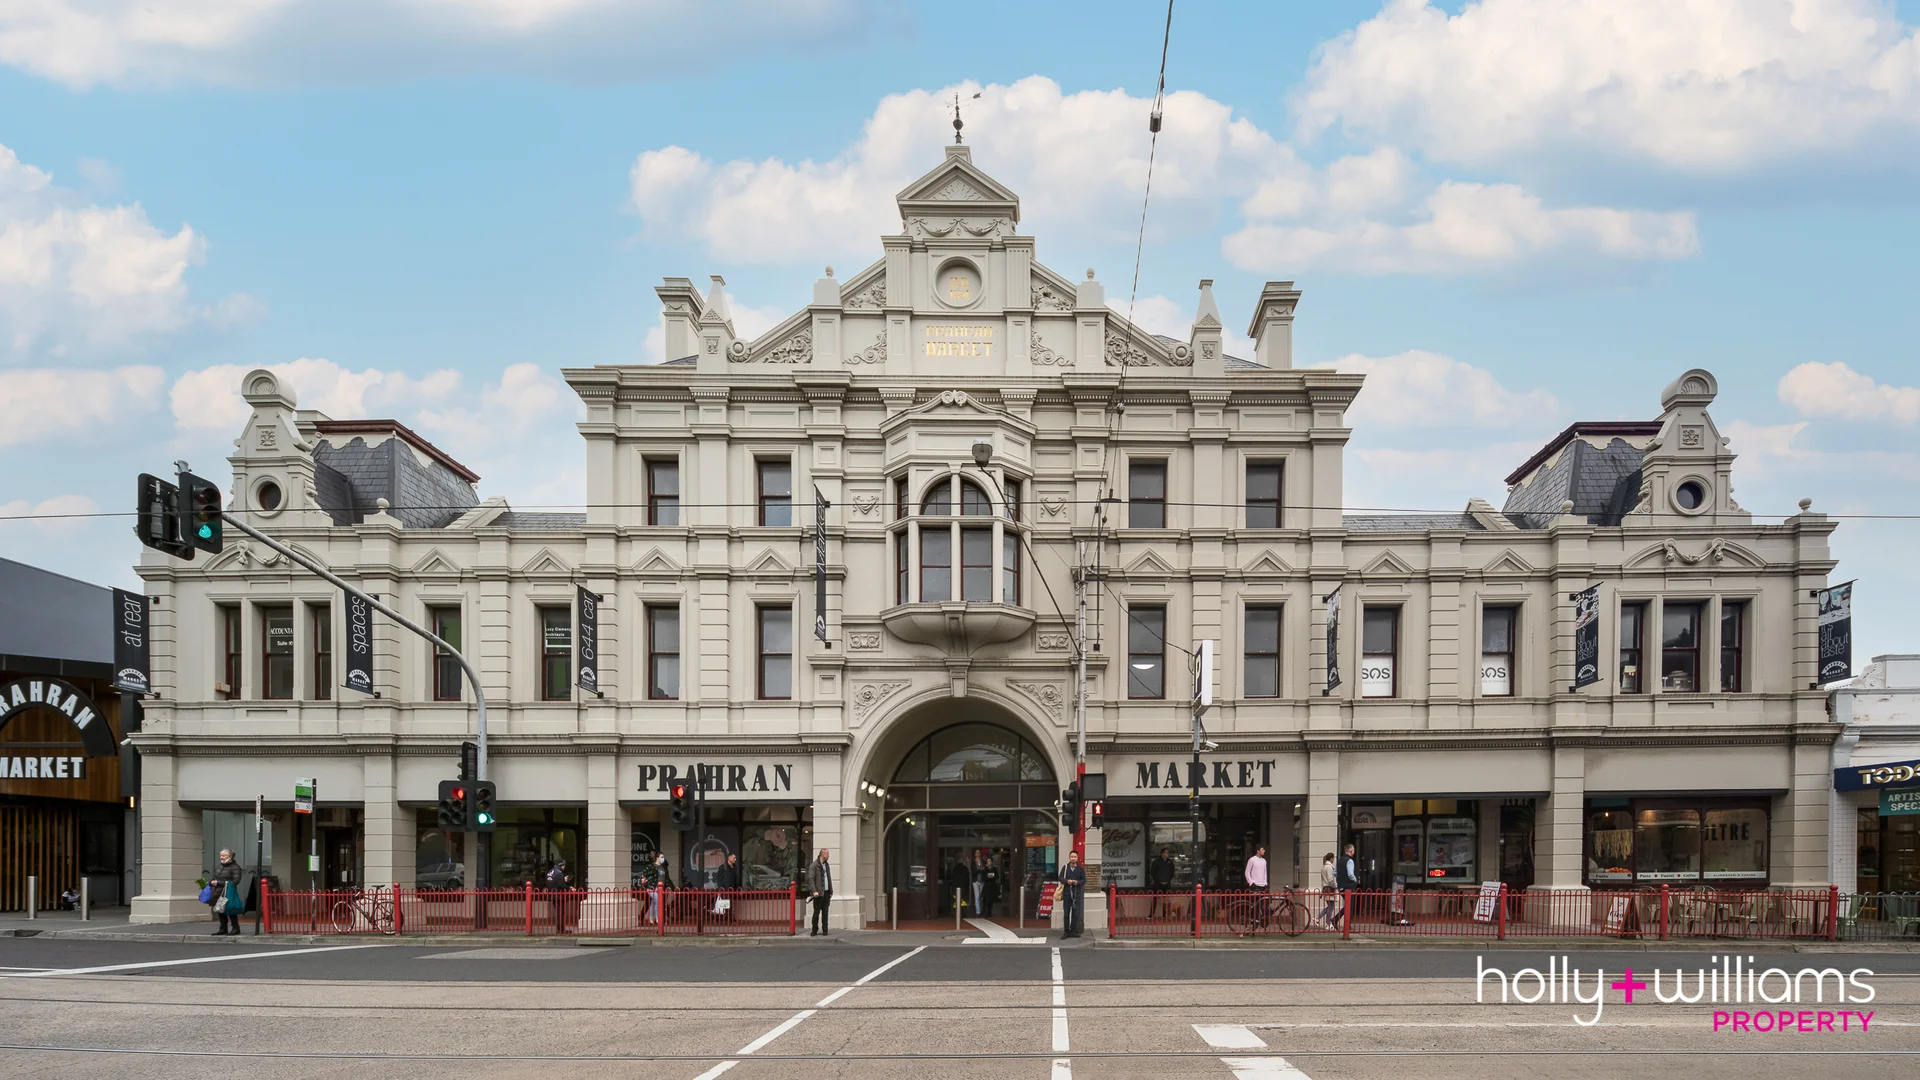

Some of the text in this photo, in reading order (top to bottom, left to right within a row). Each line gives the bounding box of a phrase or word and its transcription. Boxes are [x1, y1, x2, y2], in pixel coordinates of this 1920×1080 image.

[926, 325, 993, 337] PRAHRAN
[926, 341, 993, 357] MARKET
[583, 592, 594, 619] car
[120, 595, 142, 648] at rear
[351, 596, 370, 654] spaces
[581, 623, 595, 660] 644
[637, 764, 793, 792] PRAHRAN
[1135, 759, 1276, 788] MARKET
[631, 853, 650, 862] ORE
